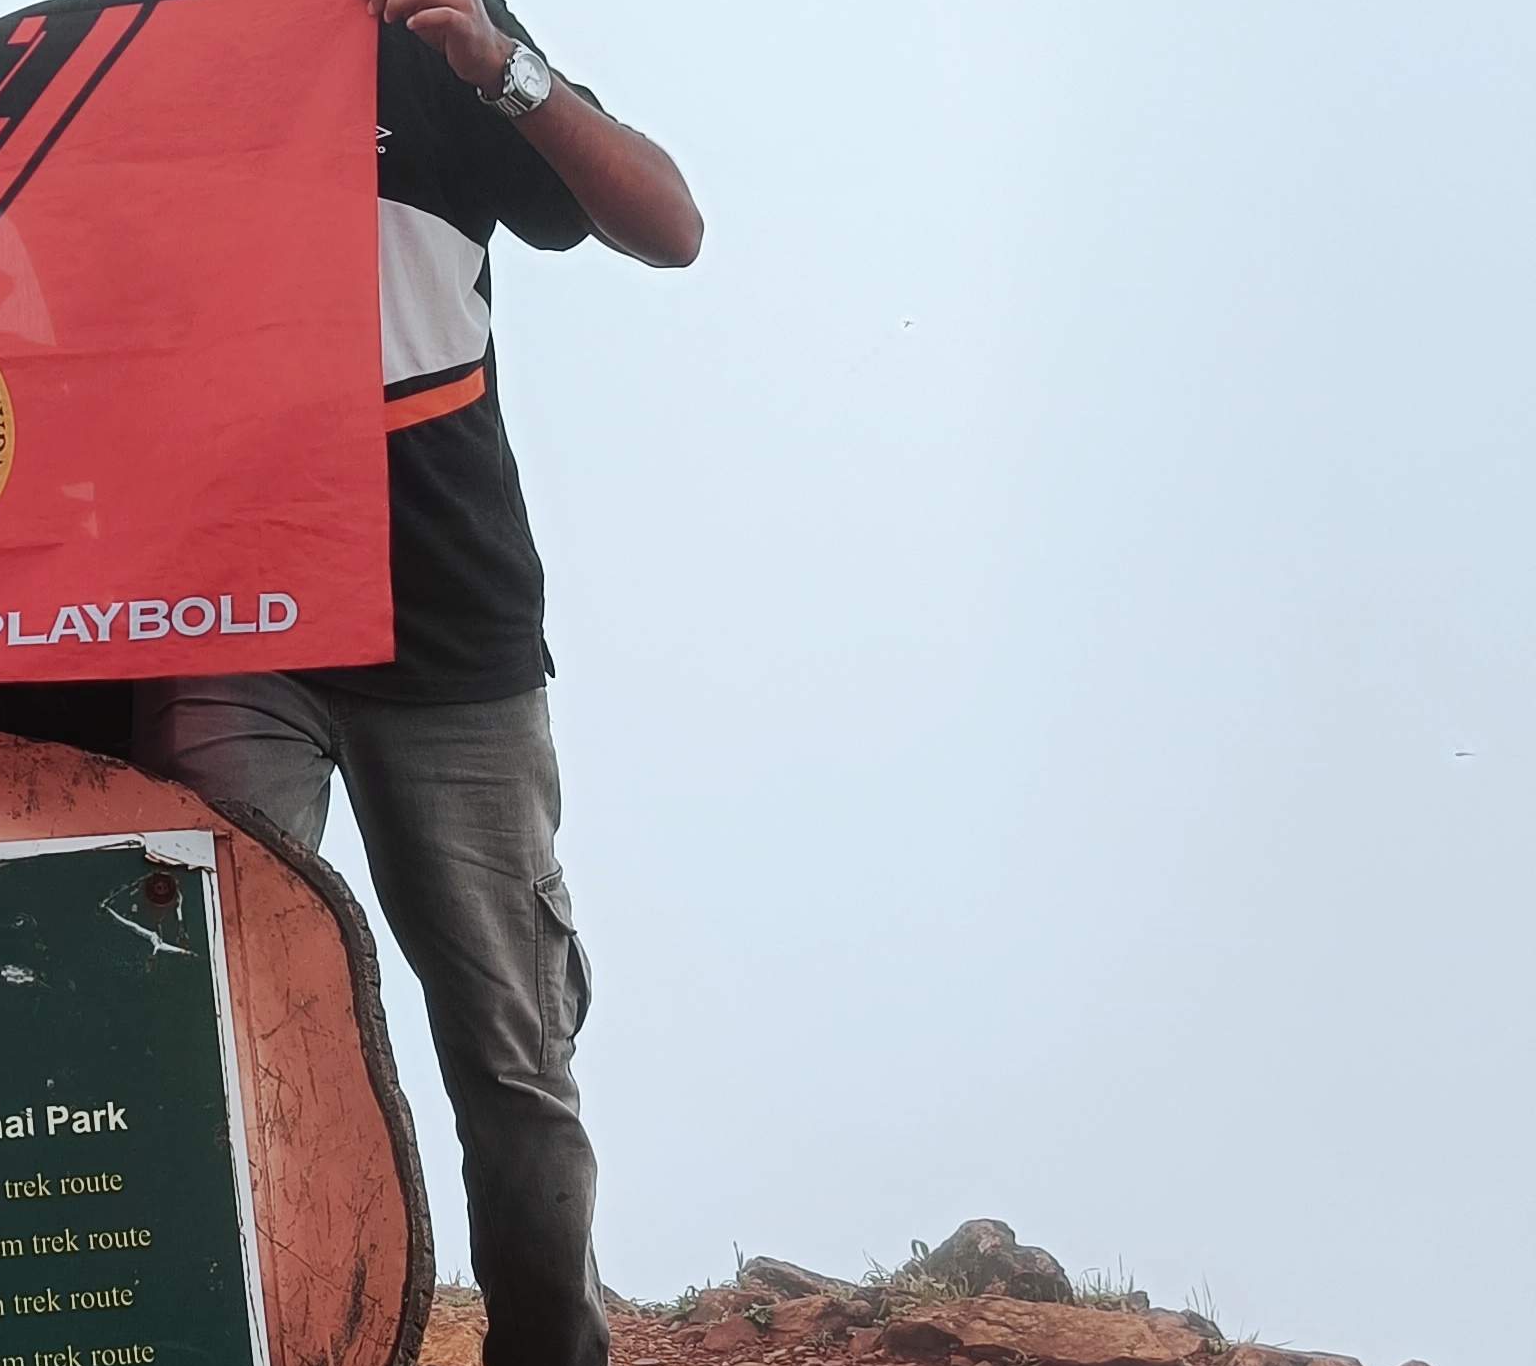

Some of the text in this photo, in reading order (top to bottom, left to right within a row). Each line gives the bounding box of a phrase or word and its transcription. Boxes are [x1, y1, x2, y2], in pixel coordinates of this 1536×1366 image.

[45, 1099, 130, 1137] Park
[4, 1172, 52, 1199] trek
[60, 1171, 124, 1195] route
[32, 1228, 80, 1255] trek
[88, 1227, 152, 1250] route
[14, 1287, 62, 1315] trek
[70, 1286, 134, 1310] route
[91, 1343, 156, 1366] route
